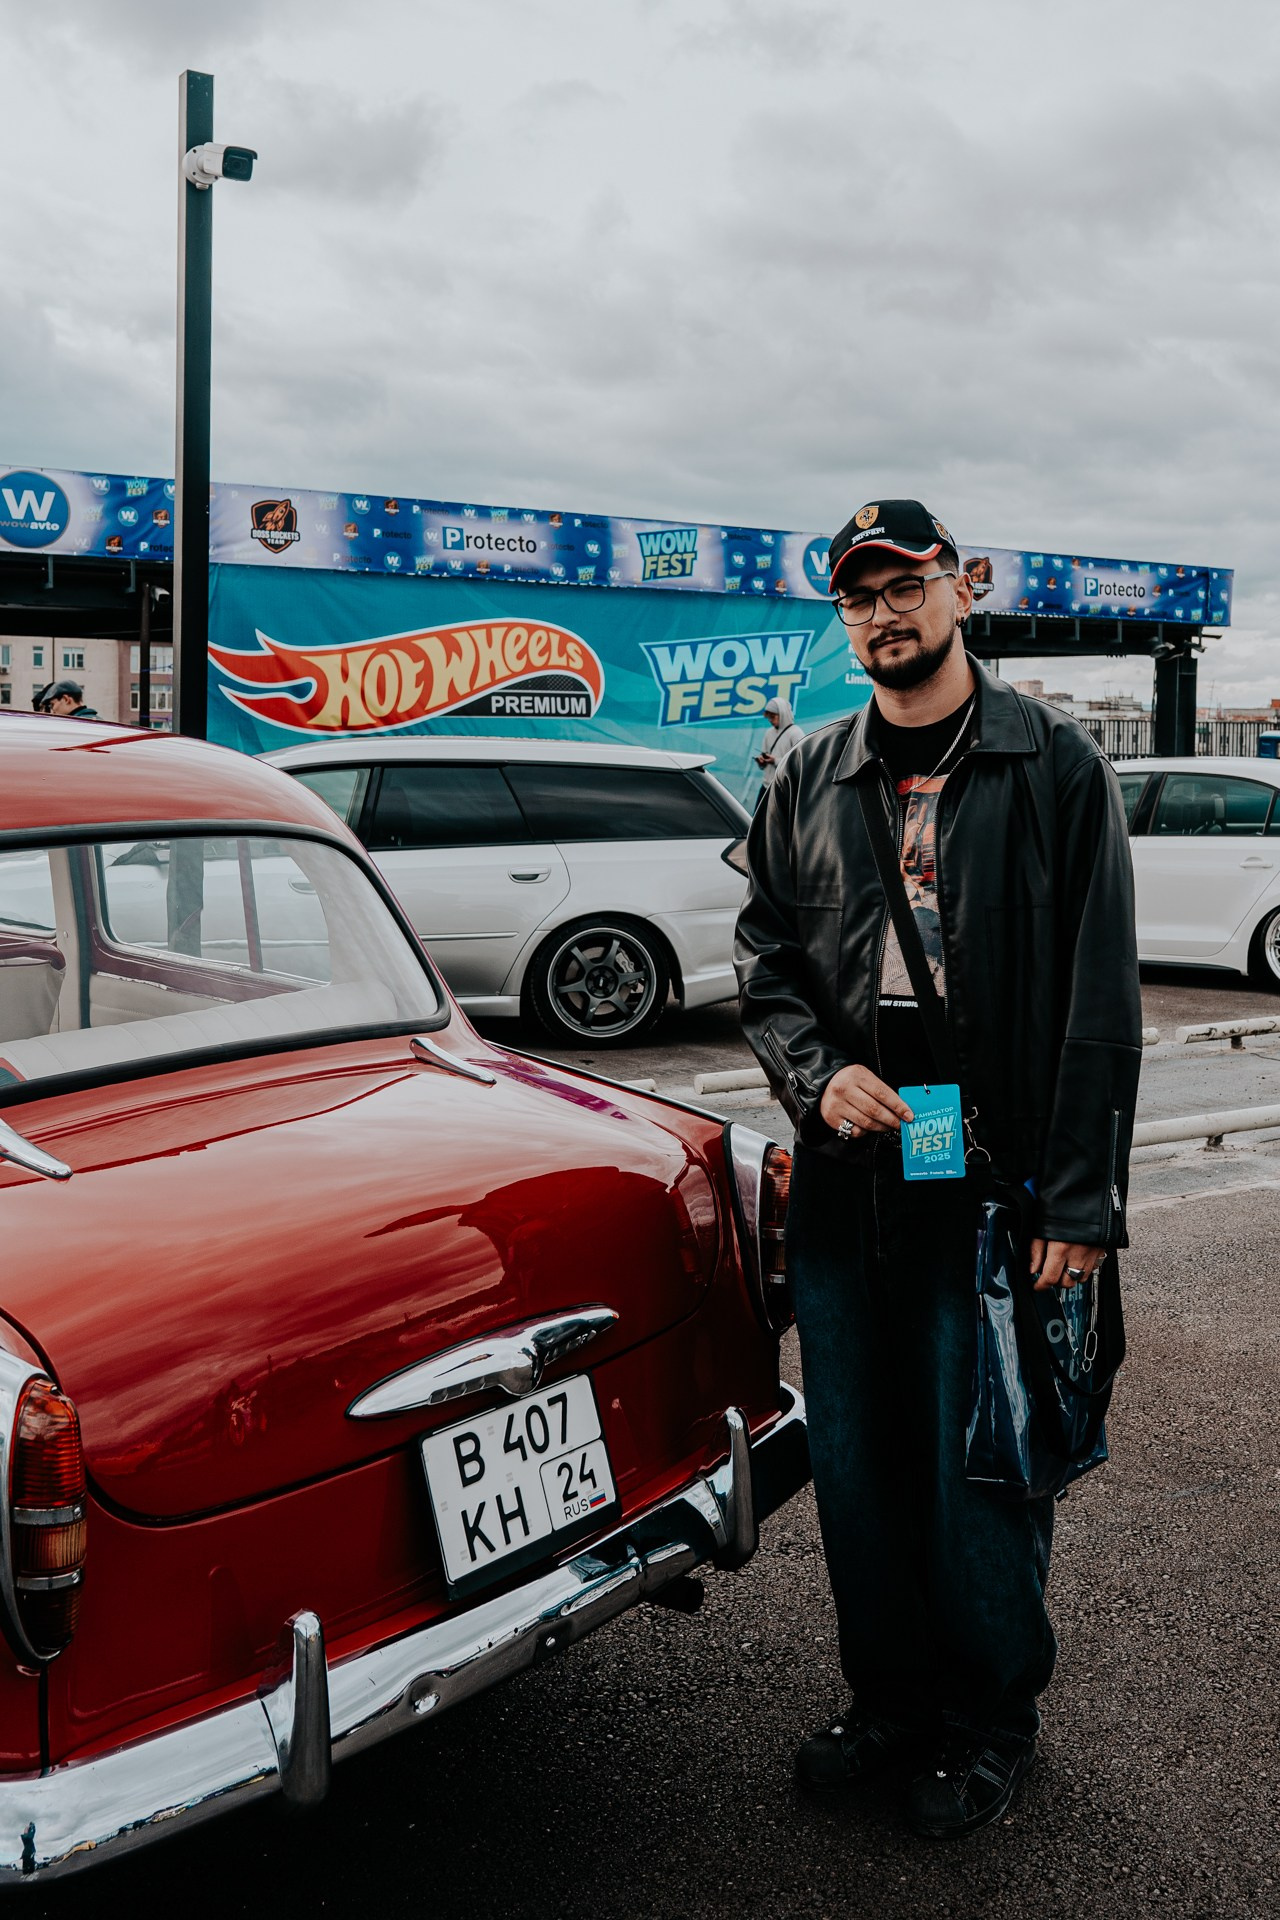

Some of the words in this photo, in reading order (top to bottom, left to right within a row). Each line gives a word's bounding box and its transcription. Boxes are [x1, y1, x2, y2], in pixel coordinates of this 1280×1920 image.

[126, 480, 149, 489] WOW
[127, 488, 147, 496] FEST
[1, 488, 56, 521] W
[0, 519, 60, 531] wowavto
[373, 528, 412, 540] Protecto
[140, 542, 174, 553] Protec
[445, 528, 537, 553] Protecto
[639, 531, 696, 556] WOW
[645, 553, 696, 578] FEST
[1085, 578, 1146, 598] Protecto
[651, 636, 804, 682] WOW
[491, 696, 587, 714] PREMIUM
[667, 674, 803, 723] FEST
[914, 1107, 954, 1119] ГАНИЗАТОР
[908, 1115, 954, 1139] WOW
[912, 1132, 954, 1155] FEST
[924, 1152, 951, 1163] 2025
[503, 1392, 568, 1462] 407
[557, 1452, 597, 1503] 24
[563, 1498, 589, 1521] RUS
